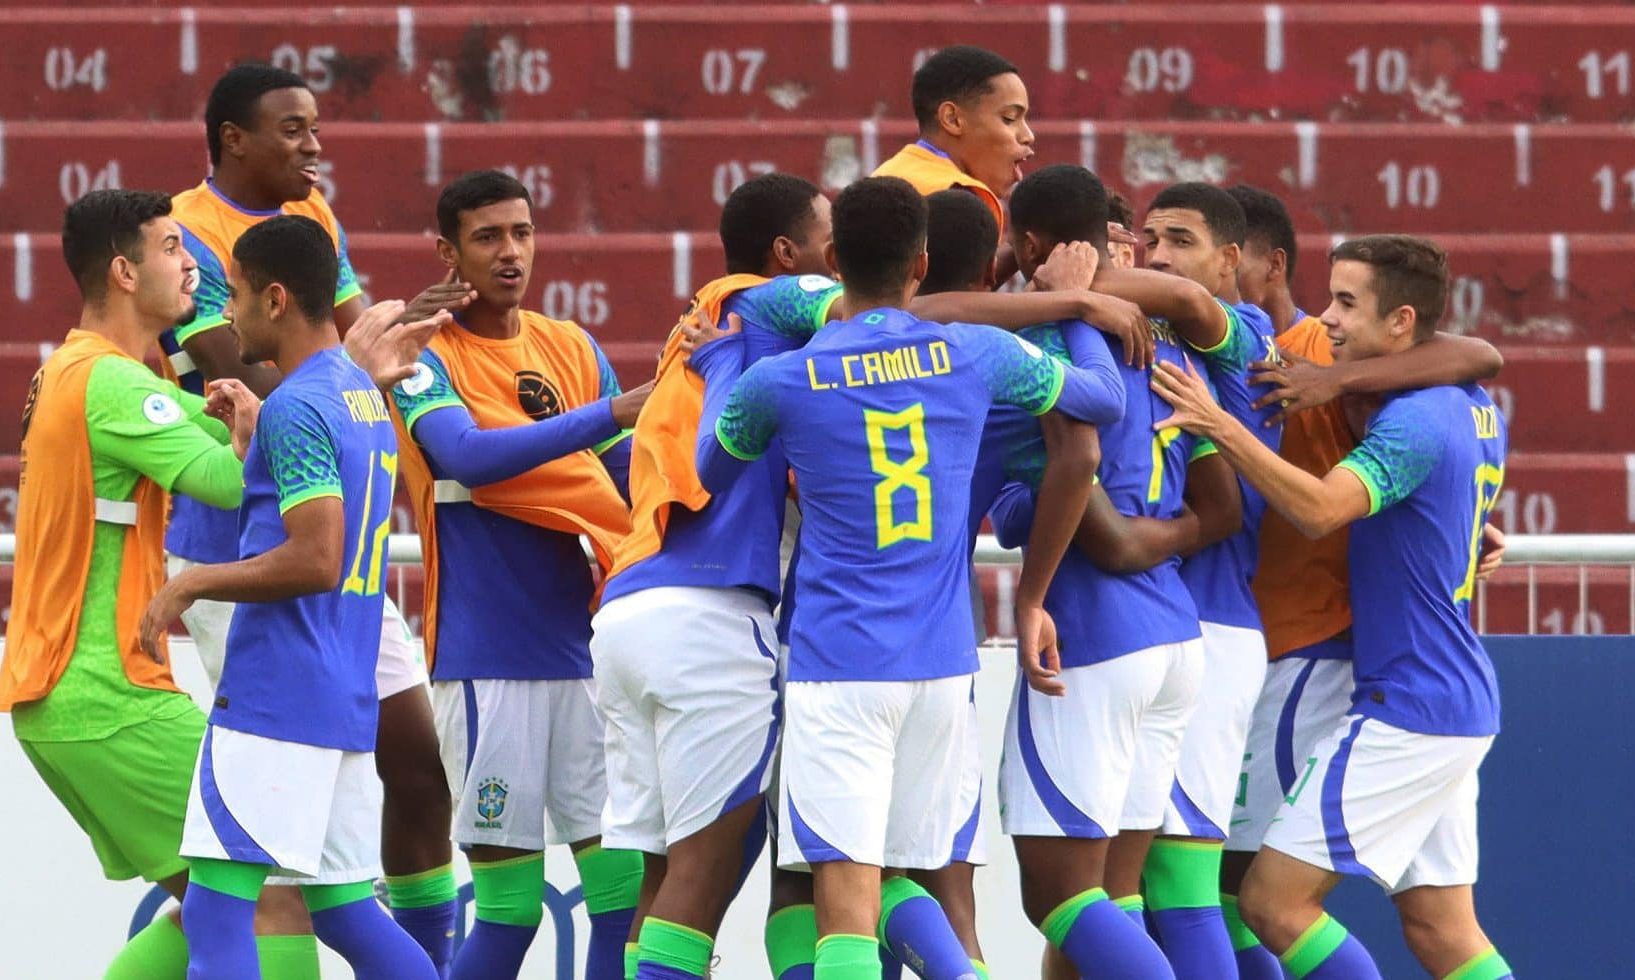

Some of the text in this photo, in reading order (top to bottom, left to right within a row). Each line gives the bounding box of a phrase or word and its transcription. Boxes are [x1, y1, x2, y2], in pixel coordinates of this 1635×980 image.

[44, 47, 107, 91] 04
[488, 48, 551, 94] 06
[702, 49, 765, 94] 07
[1128, 48, 1193, 92] 09
[1346, 47, 1408, 93] 10
[1578, 51, 1630, 99] 11
[1378, 160, 1440, 209] 10
[542, 279, 610, 325] 06
[806, 341, 951, 391] L. CAMILO
[863, 402, 932, 550] 8
[1496, 488, 1556, 534] 10
